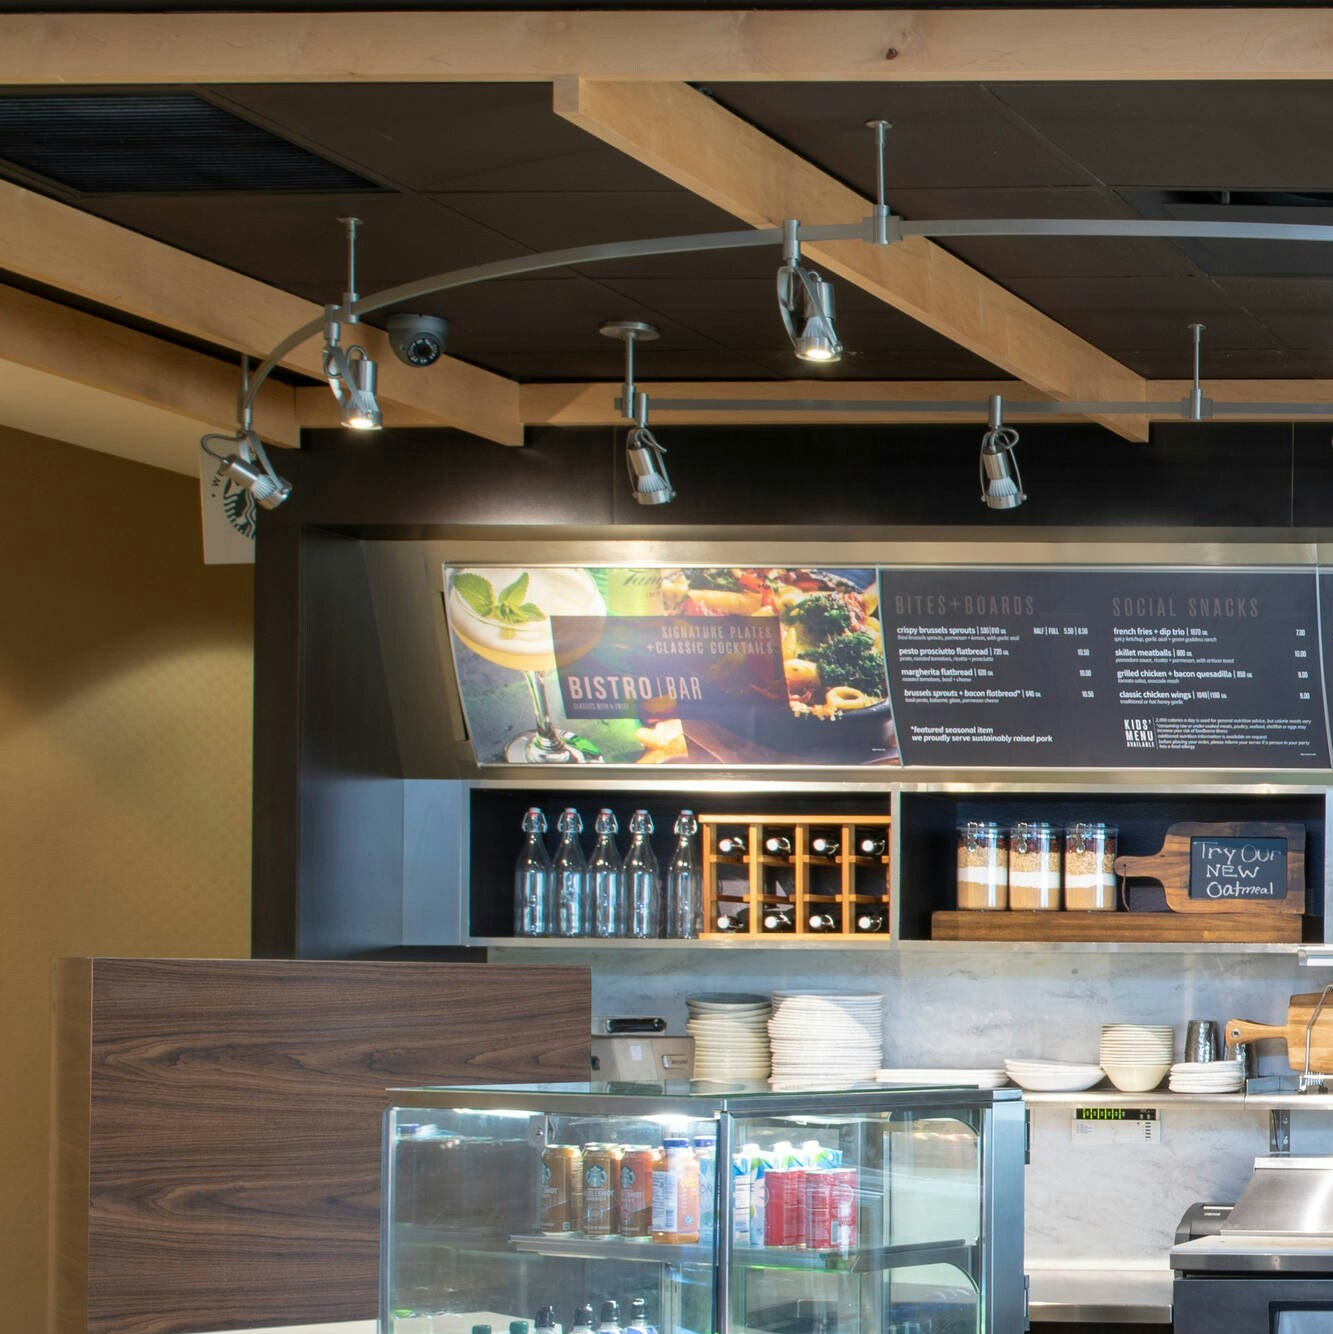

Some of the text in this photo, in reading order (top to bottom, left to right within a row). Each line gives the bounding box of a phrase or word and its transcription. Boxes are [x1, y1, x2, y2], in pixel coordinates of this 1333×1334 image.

[1112, 597, 1259, 618] SOCIAL SNACKS
[661, 625, 772, 639] SIGNATURE PLATES
[897, 626, 918, 635] crispy
[919, 626, 948, 634] brussels
[1160, 628, 1171, 636] dip
[711, 641, 774, 655] COCKTAILS
[899, 648, 919, 656] pesto
[920, 648, 955, 656] prosciutto
[901, 669, 940, 677] margherita
[1117, 670, 1139, 678] grilled
[1196, 670, 1232, 679] quesadilla
[568, 676, 702, 700] BISTRO BAR
[933, 690, 958, 698] sprouts
[1170, 691, 1192, 700] wings
[1124, 720, 1152, 730] KIDS'
[924, 734, 950, 743] proudly
[972, 735, 1012, 743] sustainably
[1036, 735, 1052, 743] pork
[1126, 731, 1154, 741] MENU
[1192, 841, 1282, 865] Try Our
[1206, 864, 1260, 878] NEW
[1206, 881, 1274, 898] Oatmeal
